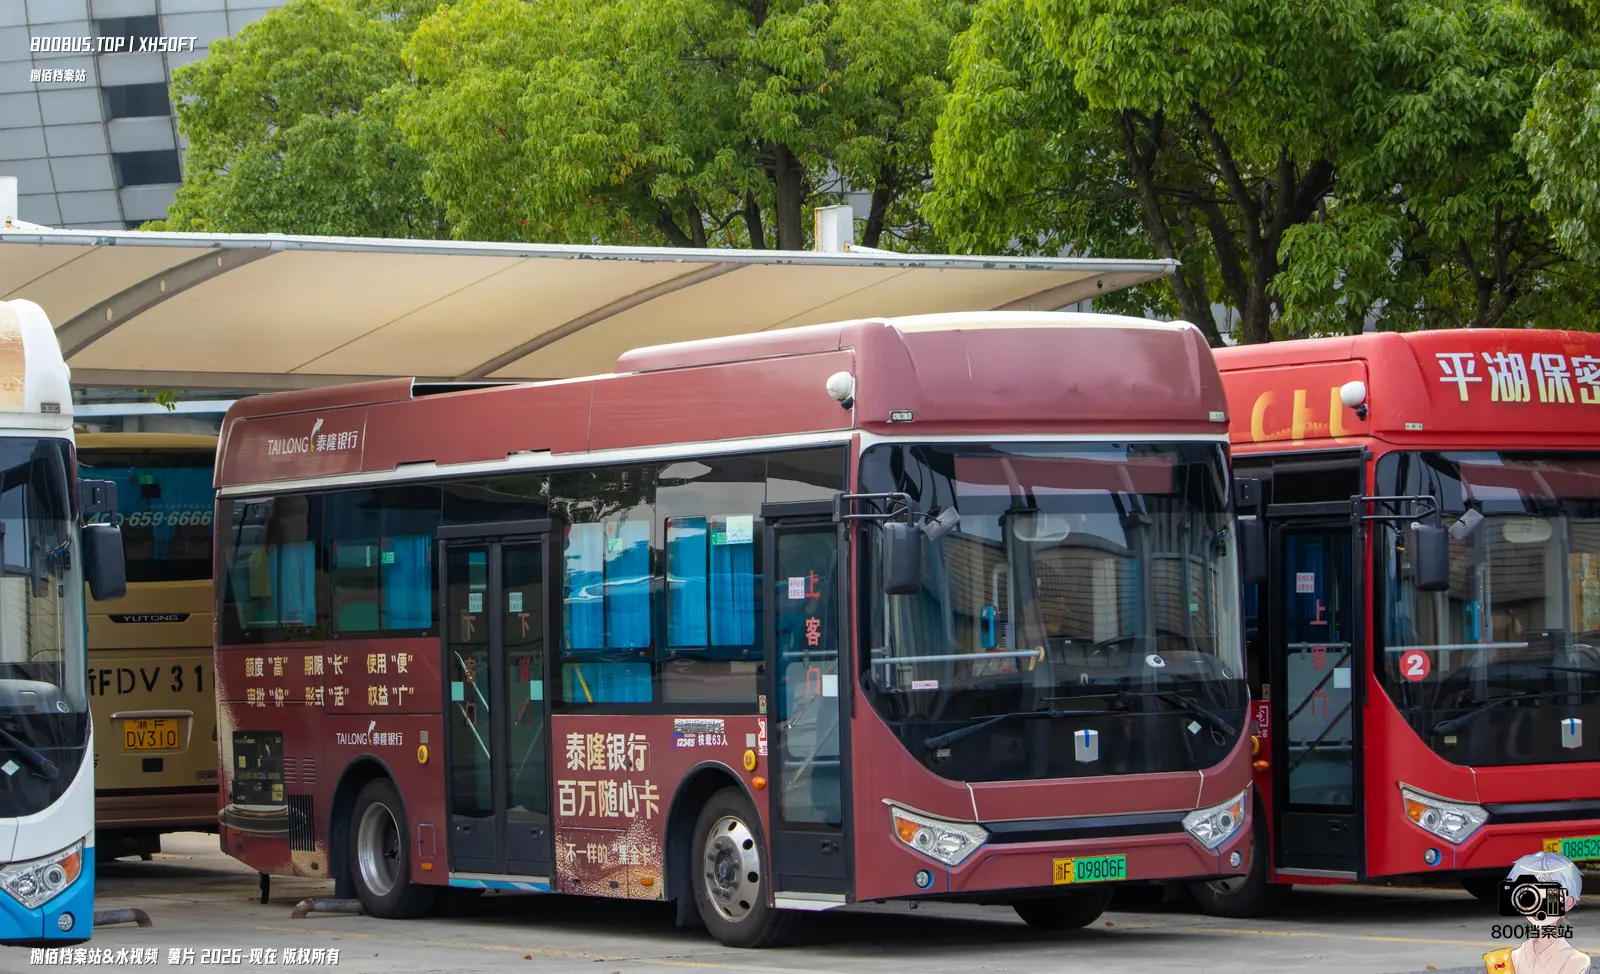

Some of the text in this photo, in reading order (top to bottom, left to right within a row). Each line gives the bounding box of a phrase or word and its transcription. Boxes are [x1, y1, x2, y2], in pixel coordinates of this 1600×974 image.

[1435, 352, 1600, 404] 平湖保密
[267, 430, 358, 455] TAILONG 泰隆银行
[1407, 655, 1424, 676] 2
[88, 664, 216, 696] FDV31
[126, 730, 176, 748] DV310
[336, 732, 403, 746] TAILONG 泰隆银行
[676, 733, 729, 747] 12345 核载63人
[565, 732, 649, 772] 泰隆银行
[557, 779, 660, 820] 百万随心卡
